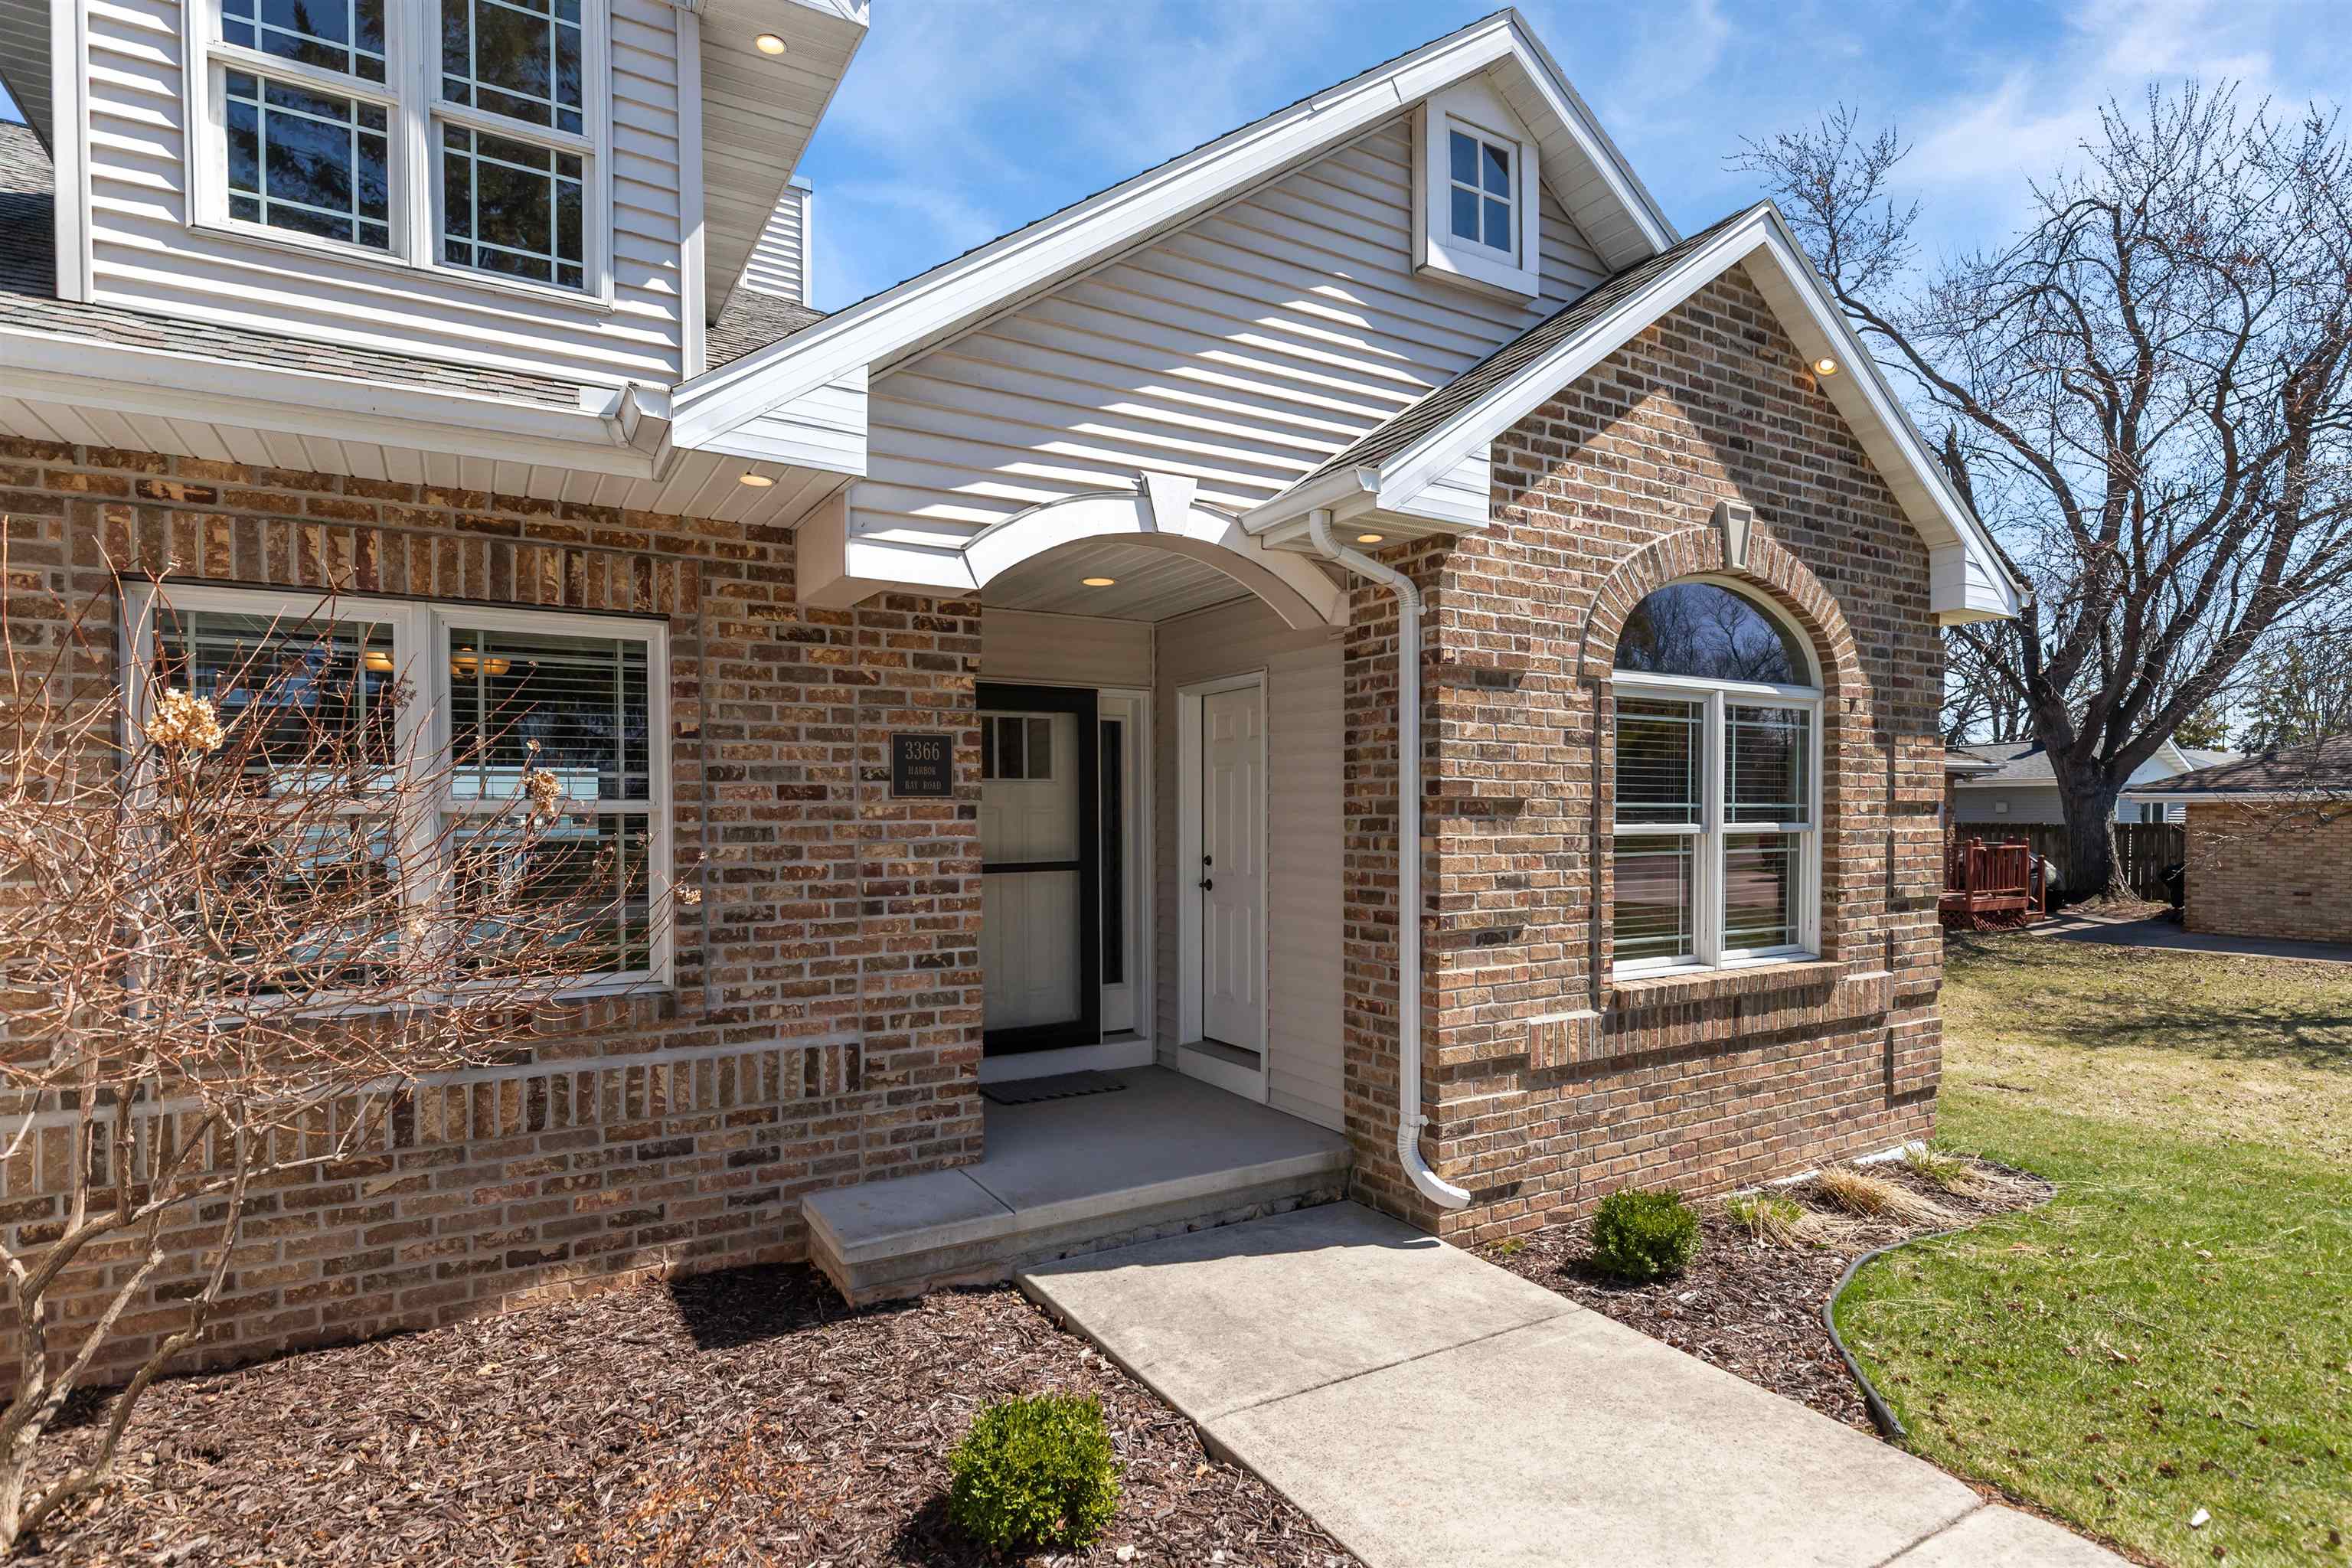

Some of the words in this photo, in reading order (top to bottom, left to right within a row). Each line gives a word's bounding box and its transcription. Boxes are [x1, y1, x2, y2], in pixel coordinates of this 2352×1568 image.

[905, 741, 940, 760] 3366
[905, 780, 918, 790] BAY
[923, 780, 942, 790] ROAD
